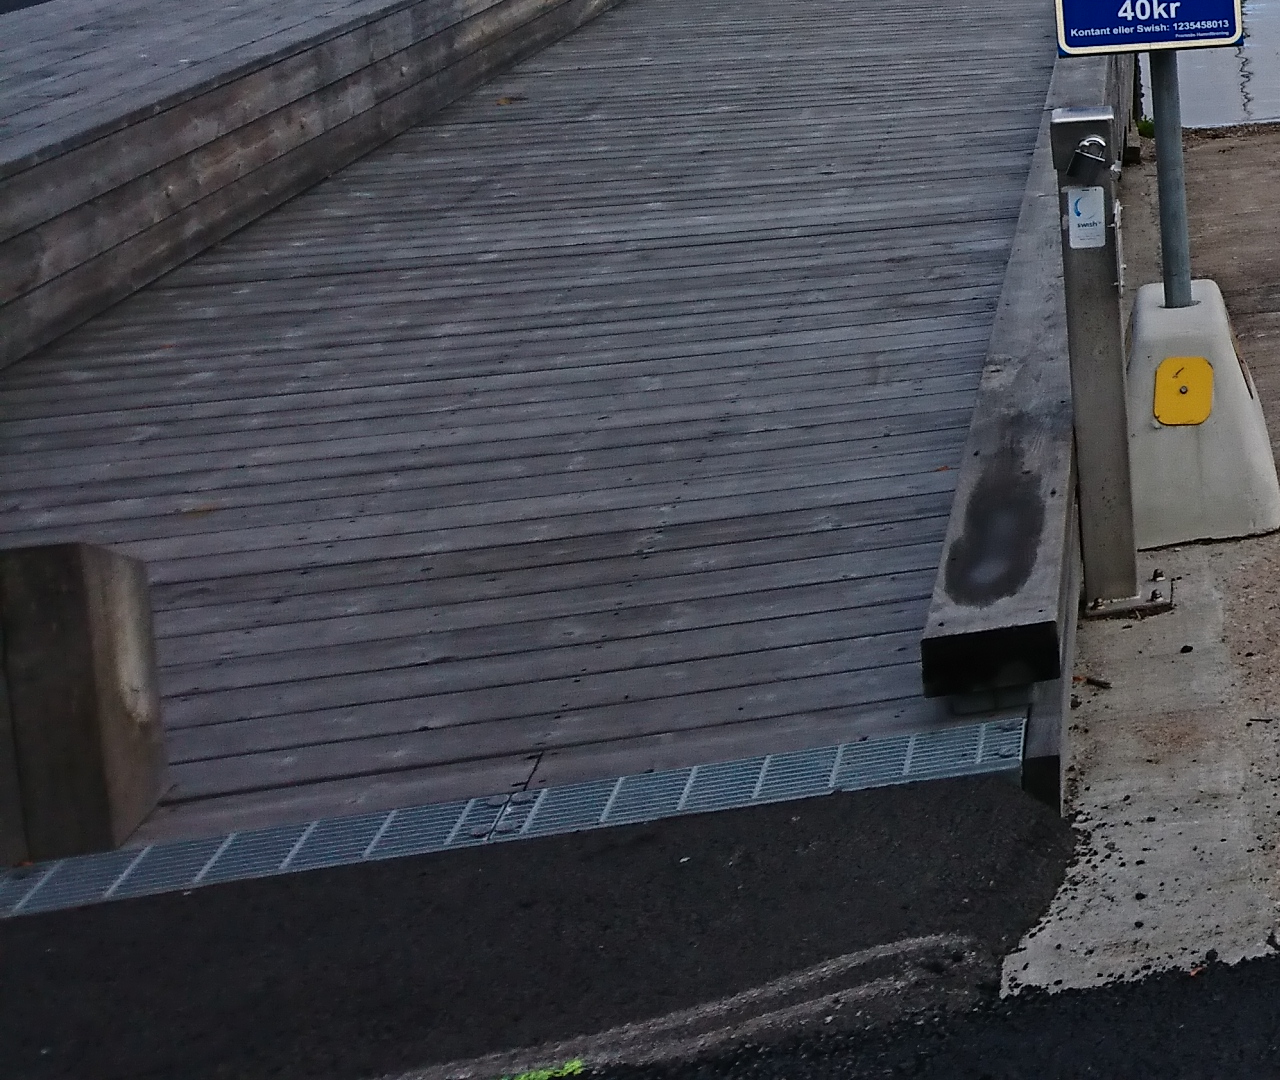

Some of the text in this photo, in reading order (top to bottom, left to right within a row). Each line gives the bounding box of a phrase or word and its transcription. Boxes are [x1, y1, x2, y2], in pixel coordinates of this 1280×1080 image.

[1070, 26, 1111, 37] Kontant
[1112, 25, 1135, 35] eller
[1136, 22, 1170, 33] Swish:
